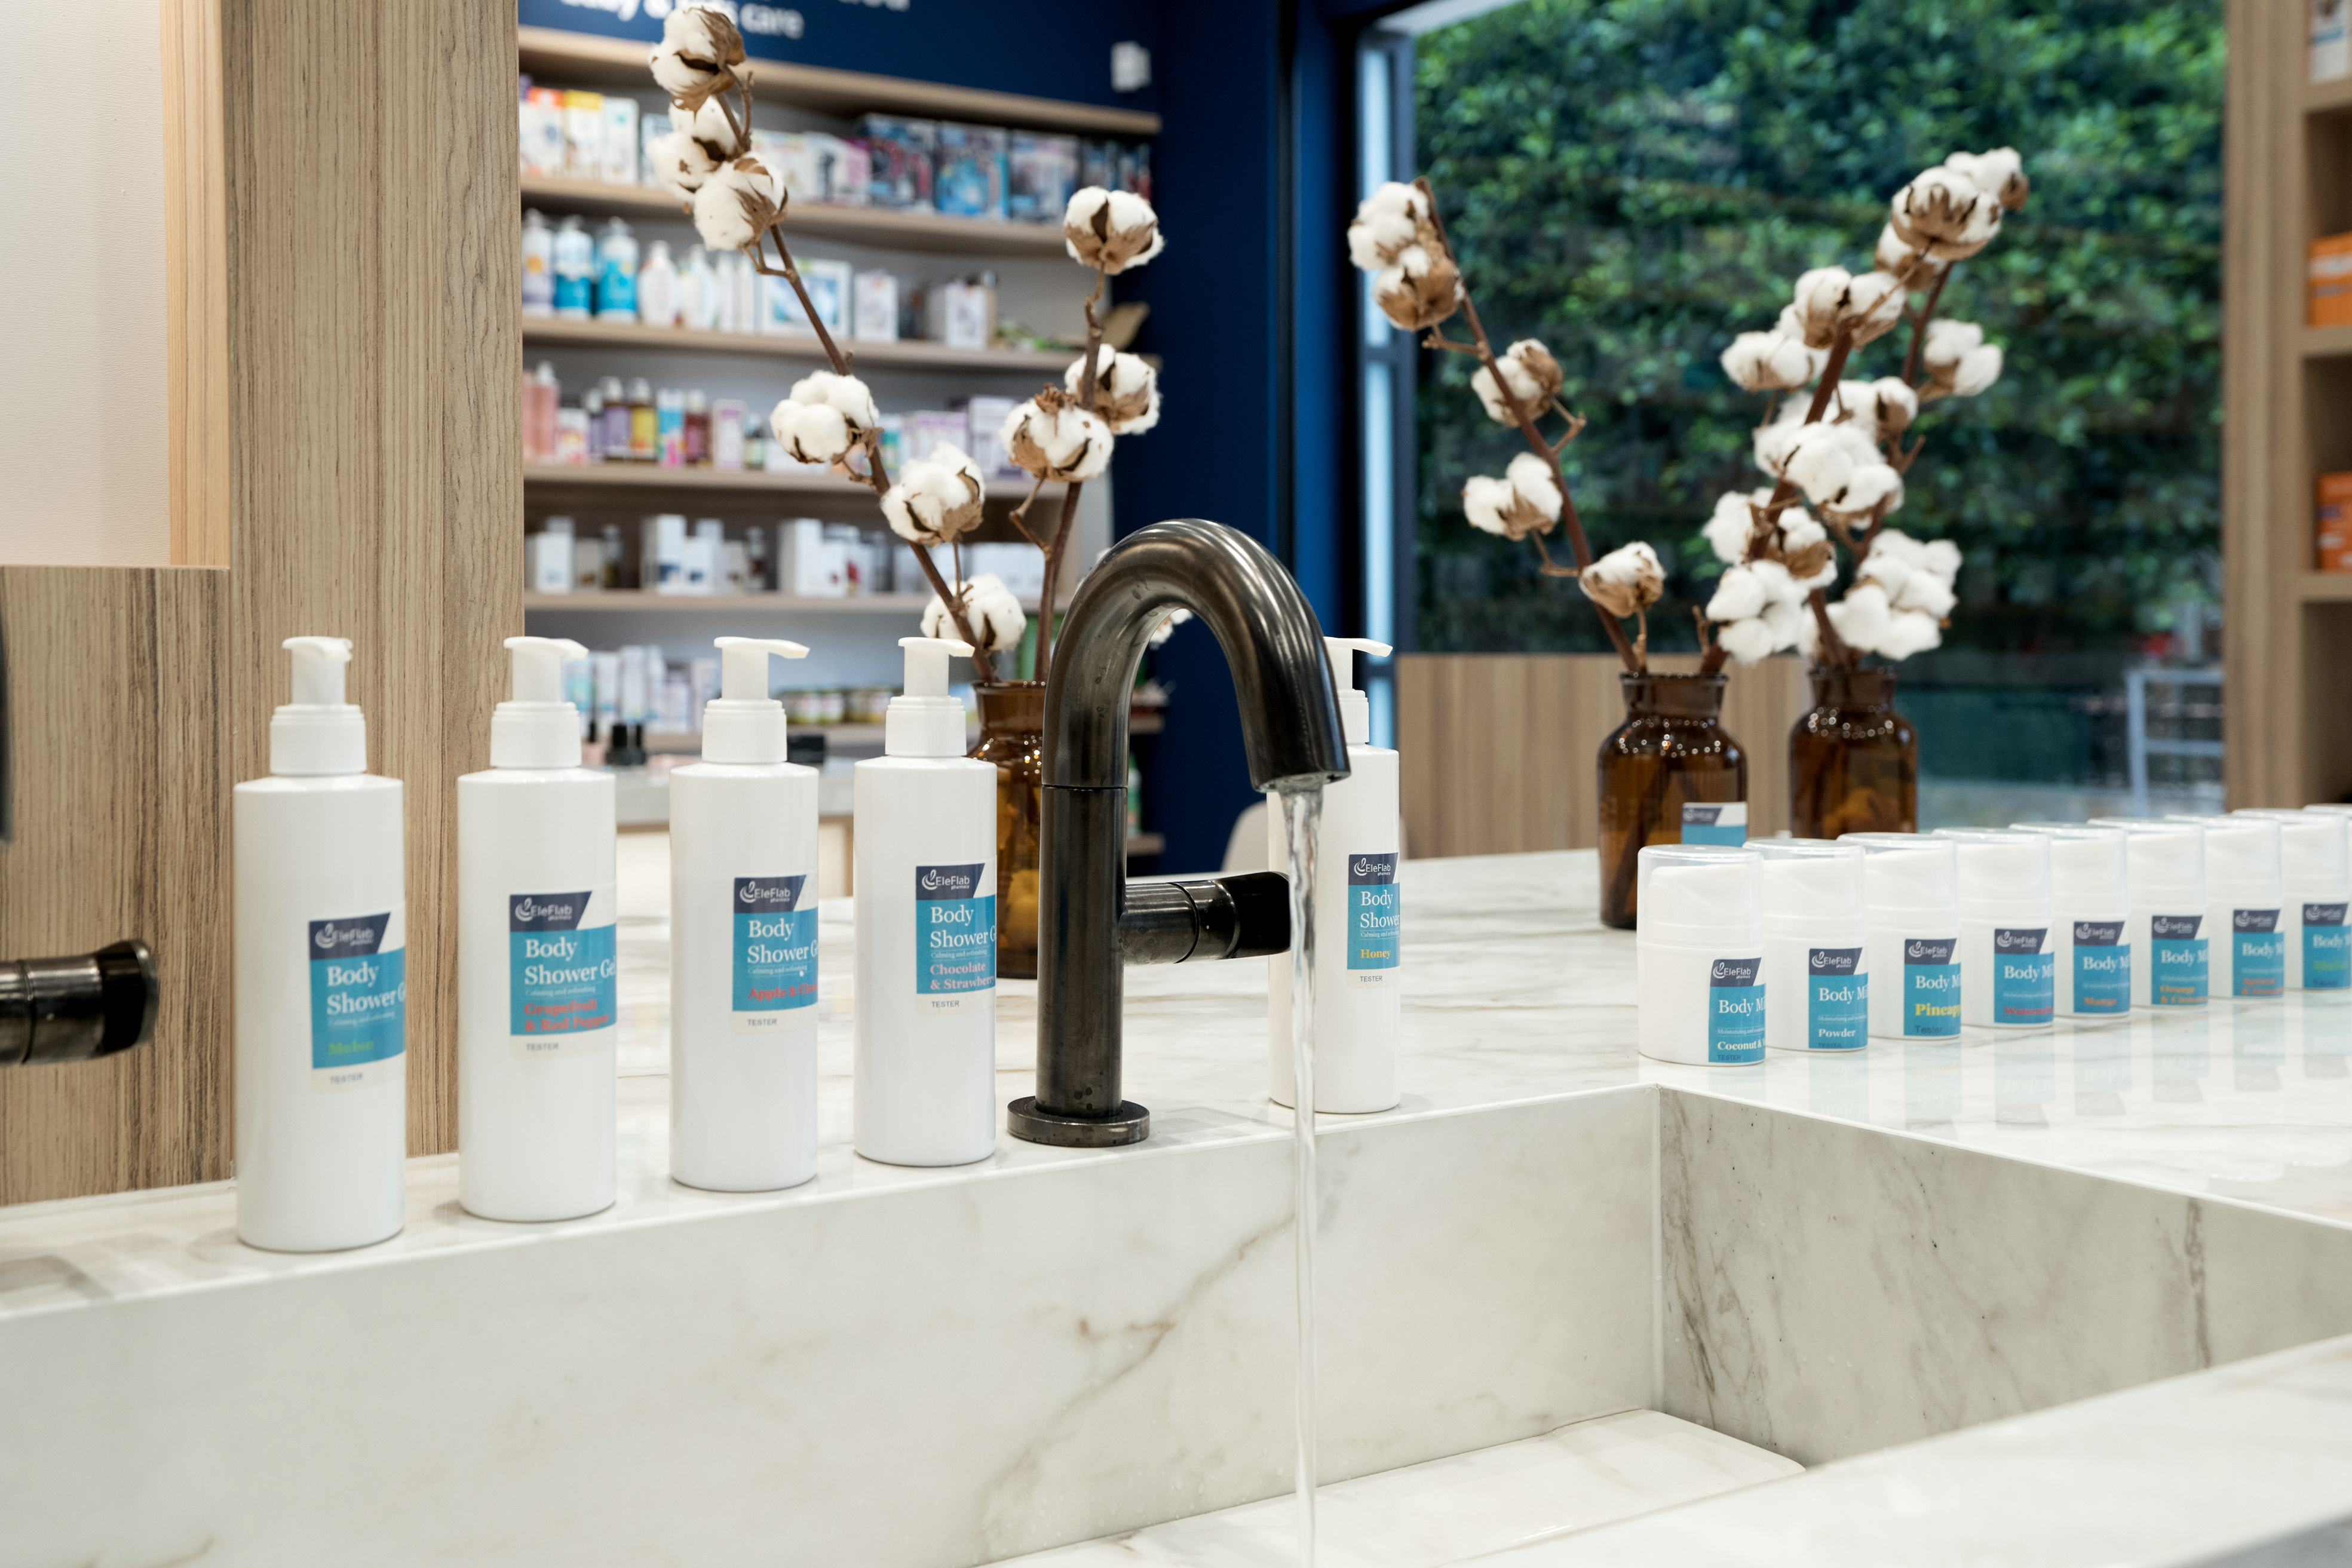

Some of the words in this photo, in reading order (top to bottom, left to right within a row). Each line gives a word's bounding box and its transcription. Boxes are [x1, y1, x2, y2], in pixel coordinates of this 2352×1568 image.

[1366, 863, 1391, 872] EleFlab
[936, 876, 970, 885] EleFlab
[754, 888, 790, 899] EleFlab
[1361, 889, 1393, 909] Body
[530, 904, 573, 917] EleFlab
[930, 904, 974, 926] Body
[1360, 912, 1400, 928] Shower
[749, 918, 794, 941] Body
[930, 929, 988, 948] Shower
[525, 936, 578, 961] Body
[747, 944, 809, 963] Shower
[1360, 949, 1391, 959] Honey
[2242, 941, 2274, 959] Body
[1823, 957, 1851, 965] EleFlab
[2083, 956, 2118, 973] Body
[2161, 949, 2195, 966] Body
[327, 961, 379, 987] Body
[525, 963, 598, 985] Shower
[930, 962, 986, 975] Chocolate
[2004, 965, 2040, 983] Body
[930, 979, 940, 990] &
[1915, 974, 1949, 992] Body
[327, 990, 396, 1015] Shower
[747, 986, 786, 1002] Apple
[789, 986, 796, 997] &
[1819, 987, 1854, 1004] Body
[525, 998, 597, 1017] Grapefruit
[1719, 999, 1753, 1016] Body
[525, 1020, 536, 1032] &
[541, 1017, 569, 1030] Red
[573, 1014, 609, 1029] Pepper
[1819, 1028, 1856, 1038] Powder
[1718, 1041, 1757, 1051] Coconut
[1758, 1039, 1762, 1048] &
